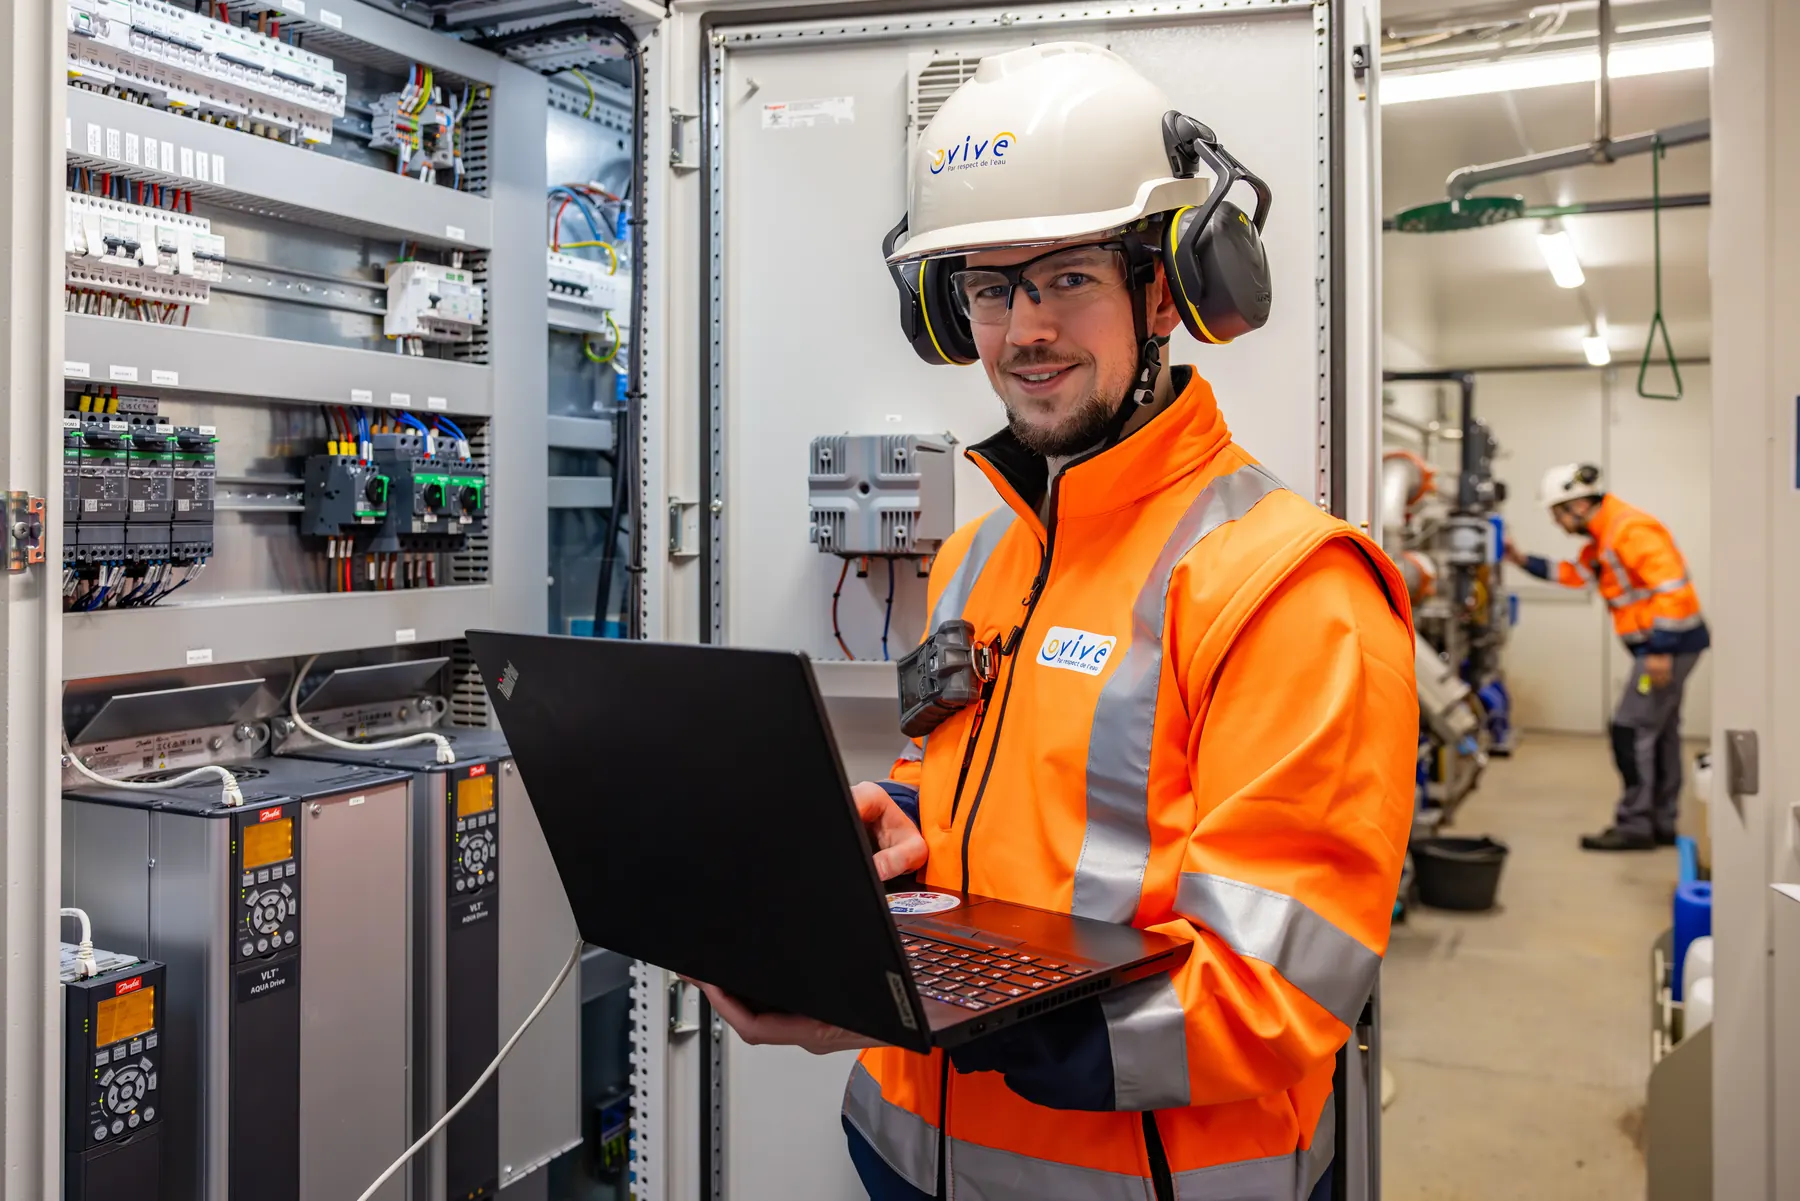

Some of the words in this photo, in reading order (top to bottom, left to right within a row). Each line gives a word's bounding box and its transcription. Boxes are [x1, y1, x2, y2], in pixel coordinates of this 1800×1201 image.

[957, 161, 979, 171] respect
[1063, 658, 1080, 667] respect
[250, 982, 269, 995] AQUA
[269, 978, 286, 988] Drive
